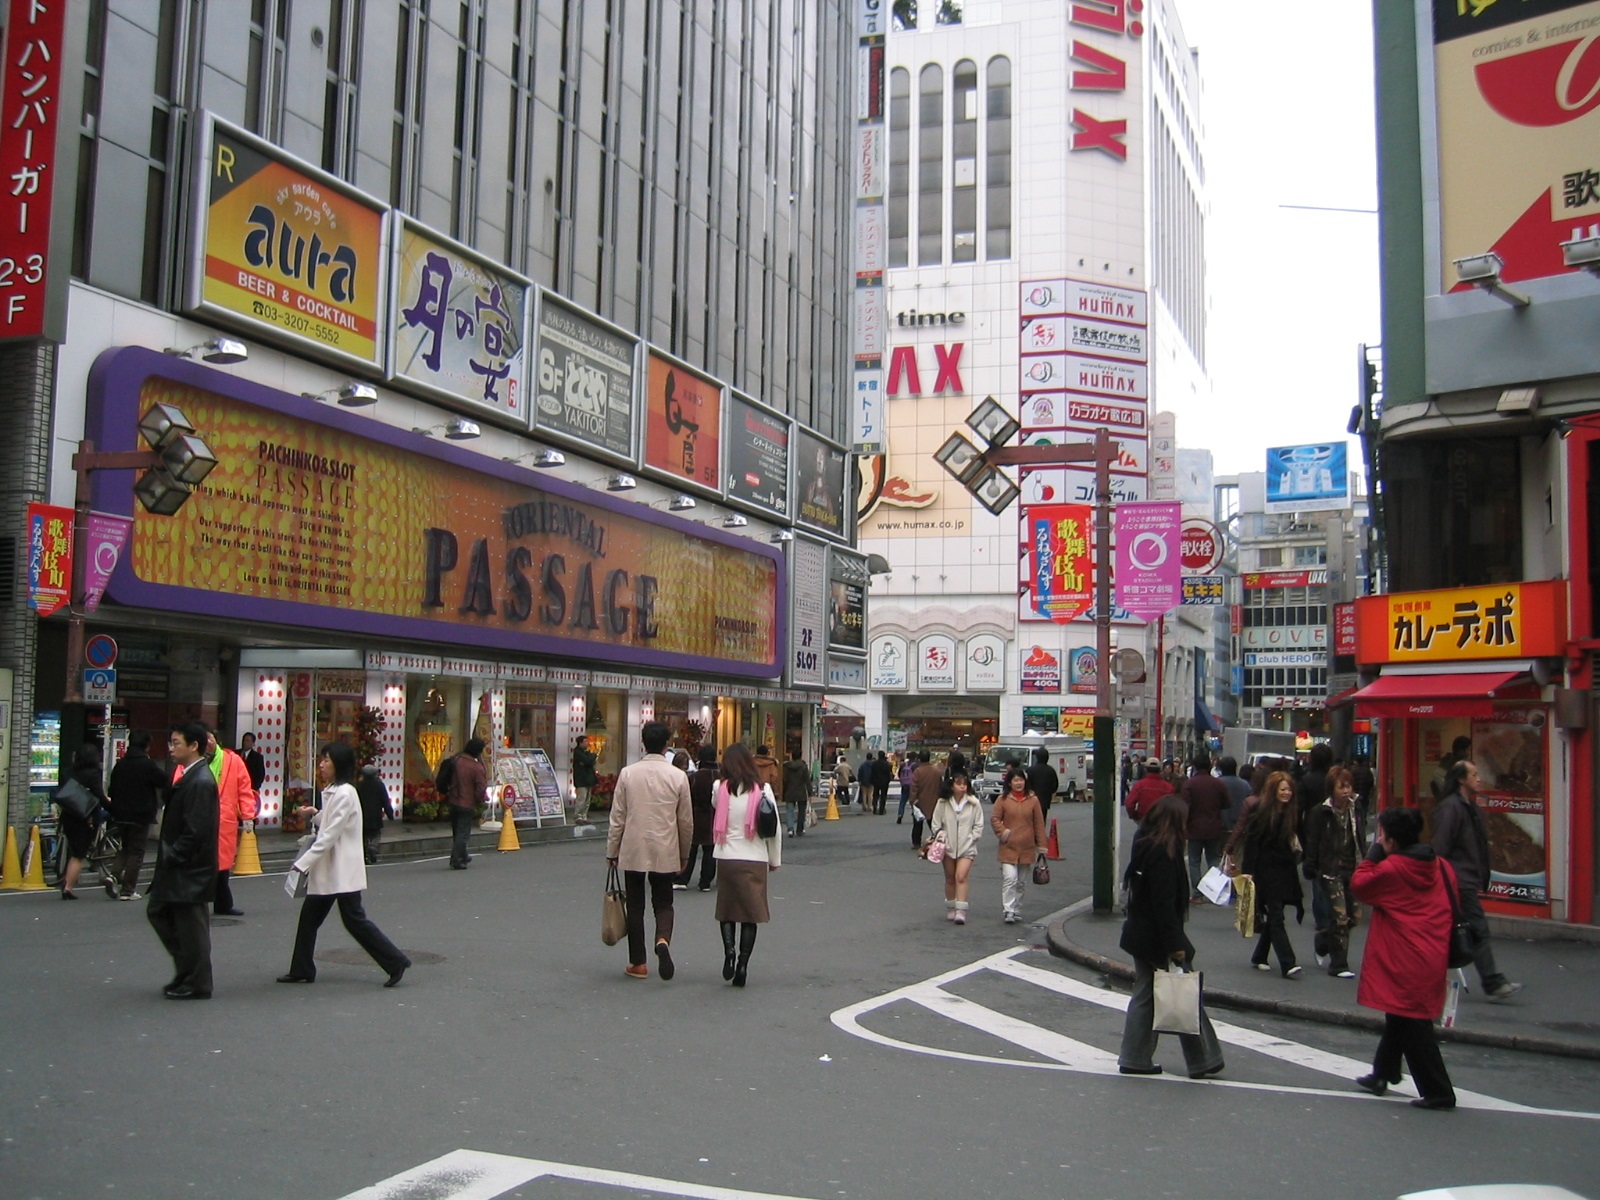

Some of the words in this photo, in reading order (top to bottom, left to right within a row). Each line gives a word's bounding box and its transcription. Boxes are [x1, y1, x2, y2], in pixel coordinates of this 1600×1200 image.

[1471, 35, 1522, 58] comics
[1526, 29, 1540, 43] &
[216, 145, 236, 184] R
[244, 204, 358, 304] aura
[8, 295, 26, 324] F
[238, 270, 276, 300] BEER
[282, 290, 290, 303] &
[297, 295, 359, 332] COCKTAIL
[897, 308, 966, 327] time
[540, 348, 563, 394] 6F
[564, 404, 607, 437] YAKITORI
[216, 487, 237, 500] which
[256, 464, 354, 510] PASSAGE
[214, 519, 251, 535] supporter
[503, 501, 607, 559] ORIENTAL
[877, 520, 964, 530] www.humax.co.jp
[201, 532, 214, 544] The
[216, 537, 231, 549] way
[233, 538, 249, 550] that
[1181, 540, 1213, 557] 消火栓
[45, 519, 68, 588] 歌舞伎町
[1054, 518, 1086, 593] 歌舞伎町
[243, 571, 260, 584] Love
[268, 573, 283, 586] ball
[422, 524, 660, 639] PASSAGE
[1123, 584, 1173, 594] 新宿コマ劇場
[1394, 591, 1516, 651] カレーデポ
[802, 628, 813, 647] 2F
[1248, 629, 1325, 645] LOVE
[369, 654, 393, 666] SLOT
[398, 656, 438, 670] PASSAGE
[796, 651, 817, 672] SLOT
[1259, 654, 1279, 663] club
[1281, 654, 1312, 663] HERO
[442, 660, 485, 674] PACHINKO
[488, 664, 507, 675] SLOT
[511, 666, 544, 679] PASSAGE
[1063, 717, 1096, 729] ゲーム
